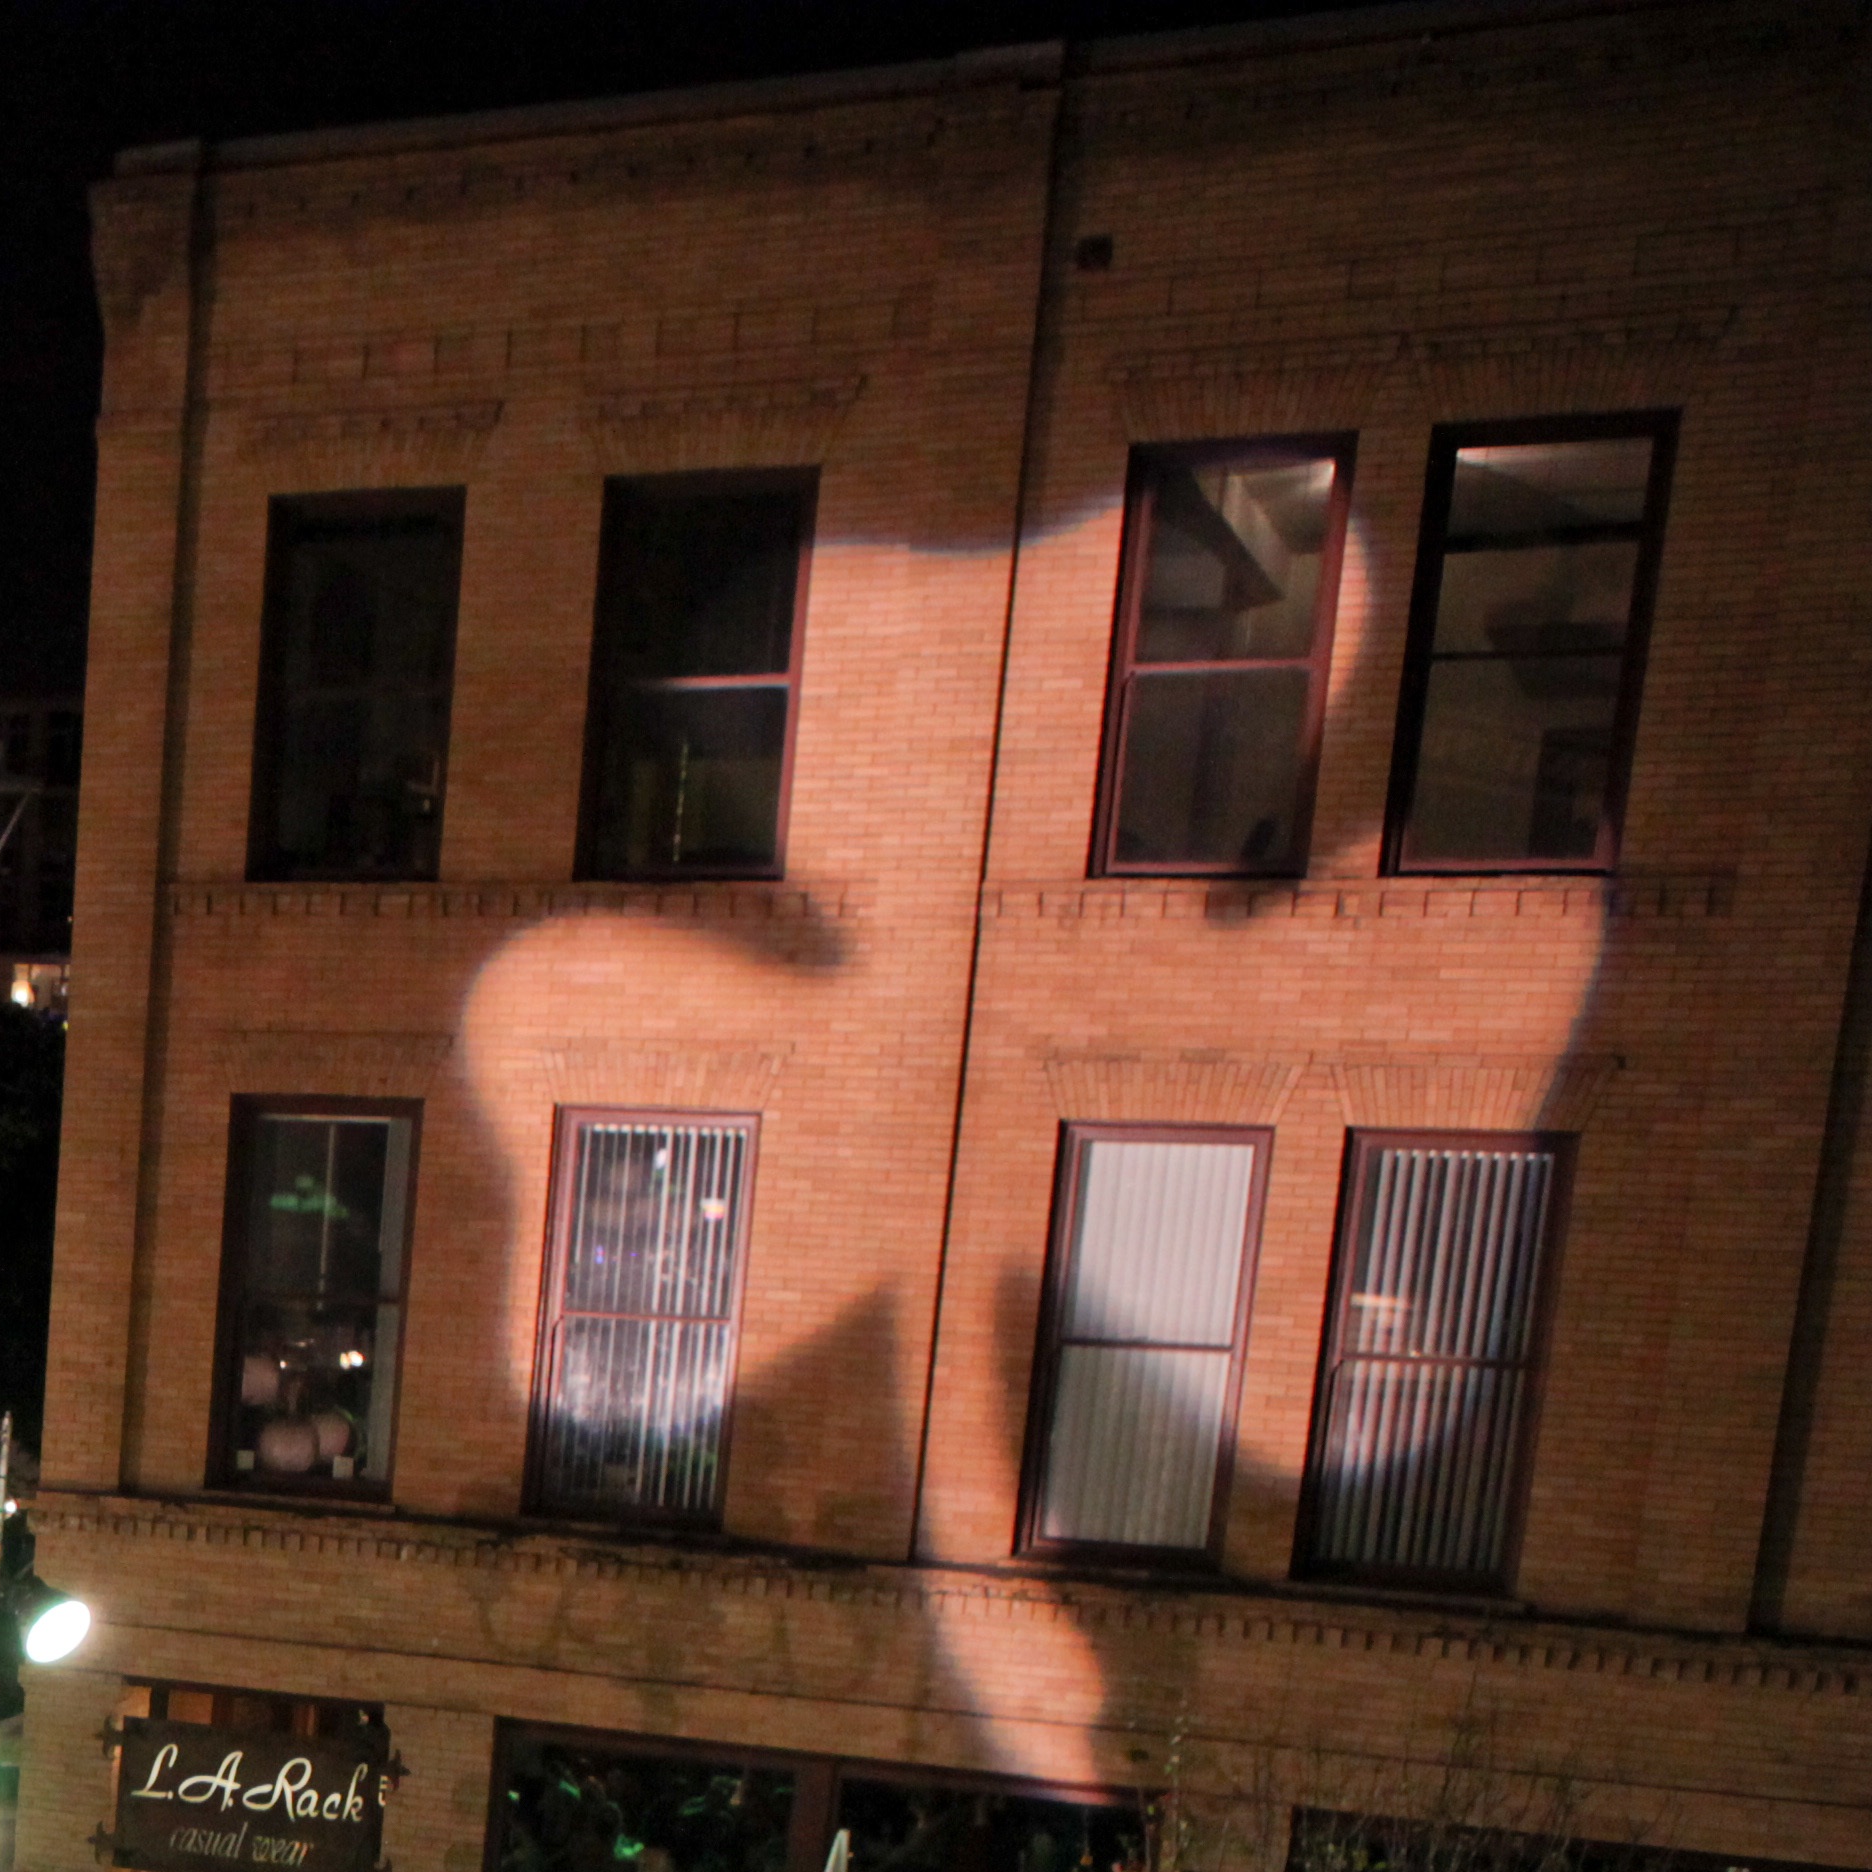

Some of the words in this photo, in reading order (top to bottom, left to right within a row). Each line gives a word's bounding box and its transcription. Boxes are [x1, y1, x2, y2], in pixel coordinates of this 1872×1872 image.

[130, 1743, 244, 1813] L.A.
[242, 1756, 369, 1823] Rack
[169, 1820, 249, 1860] casual
[252, 1834, 314, 1867] wear
